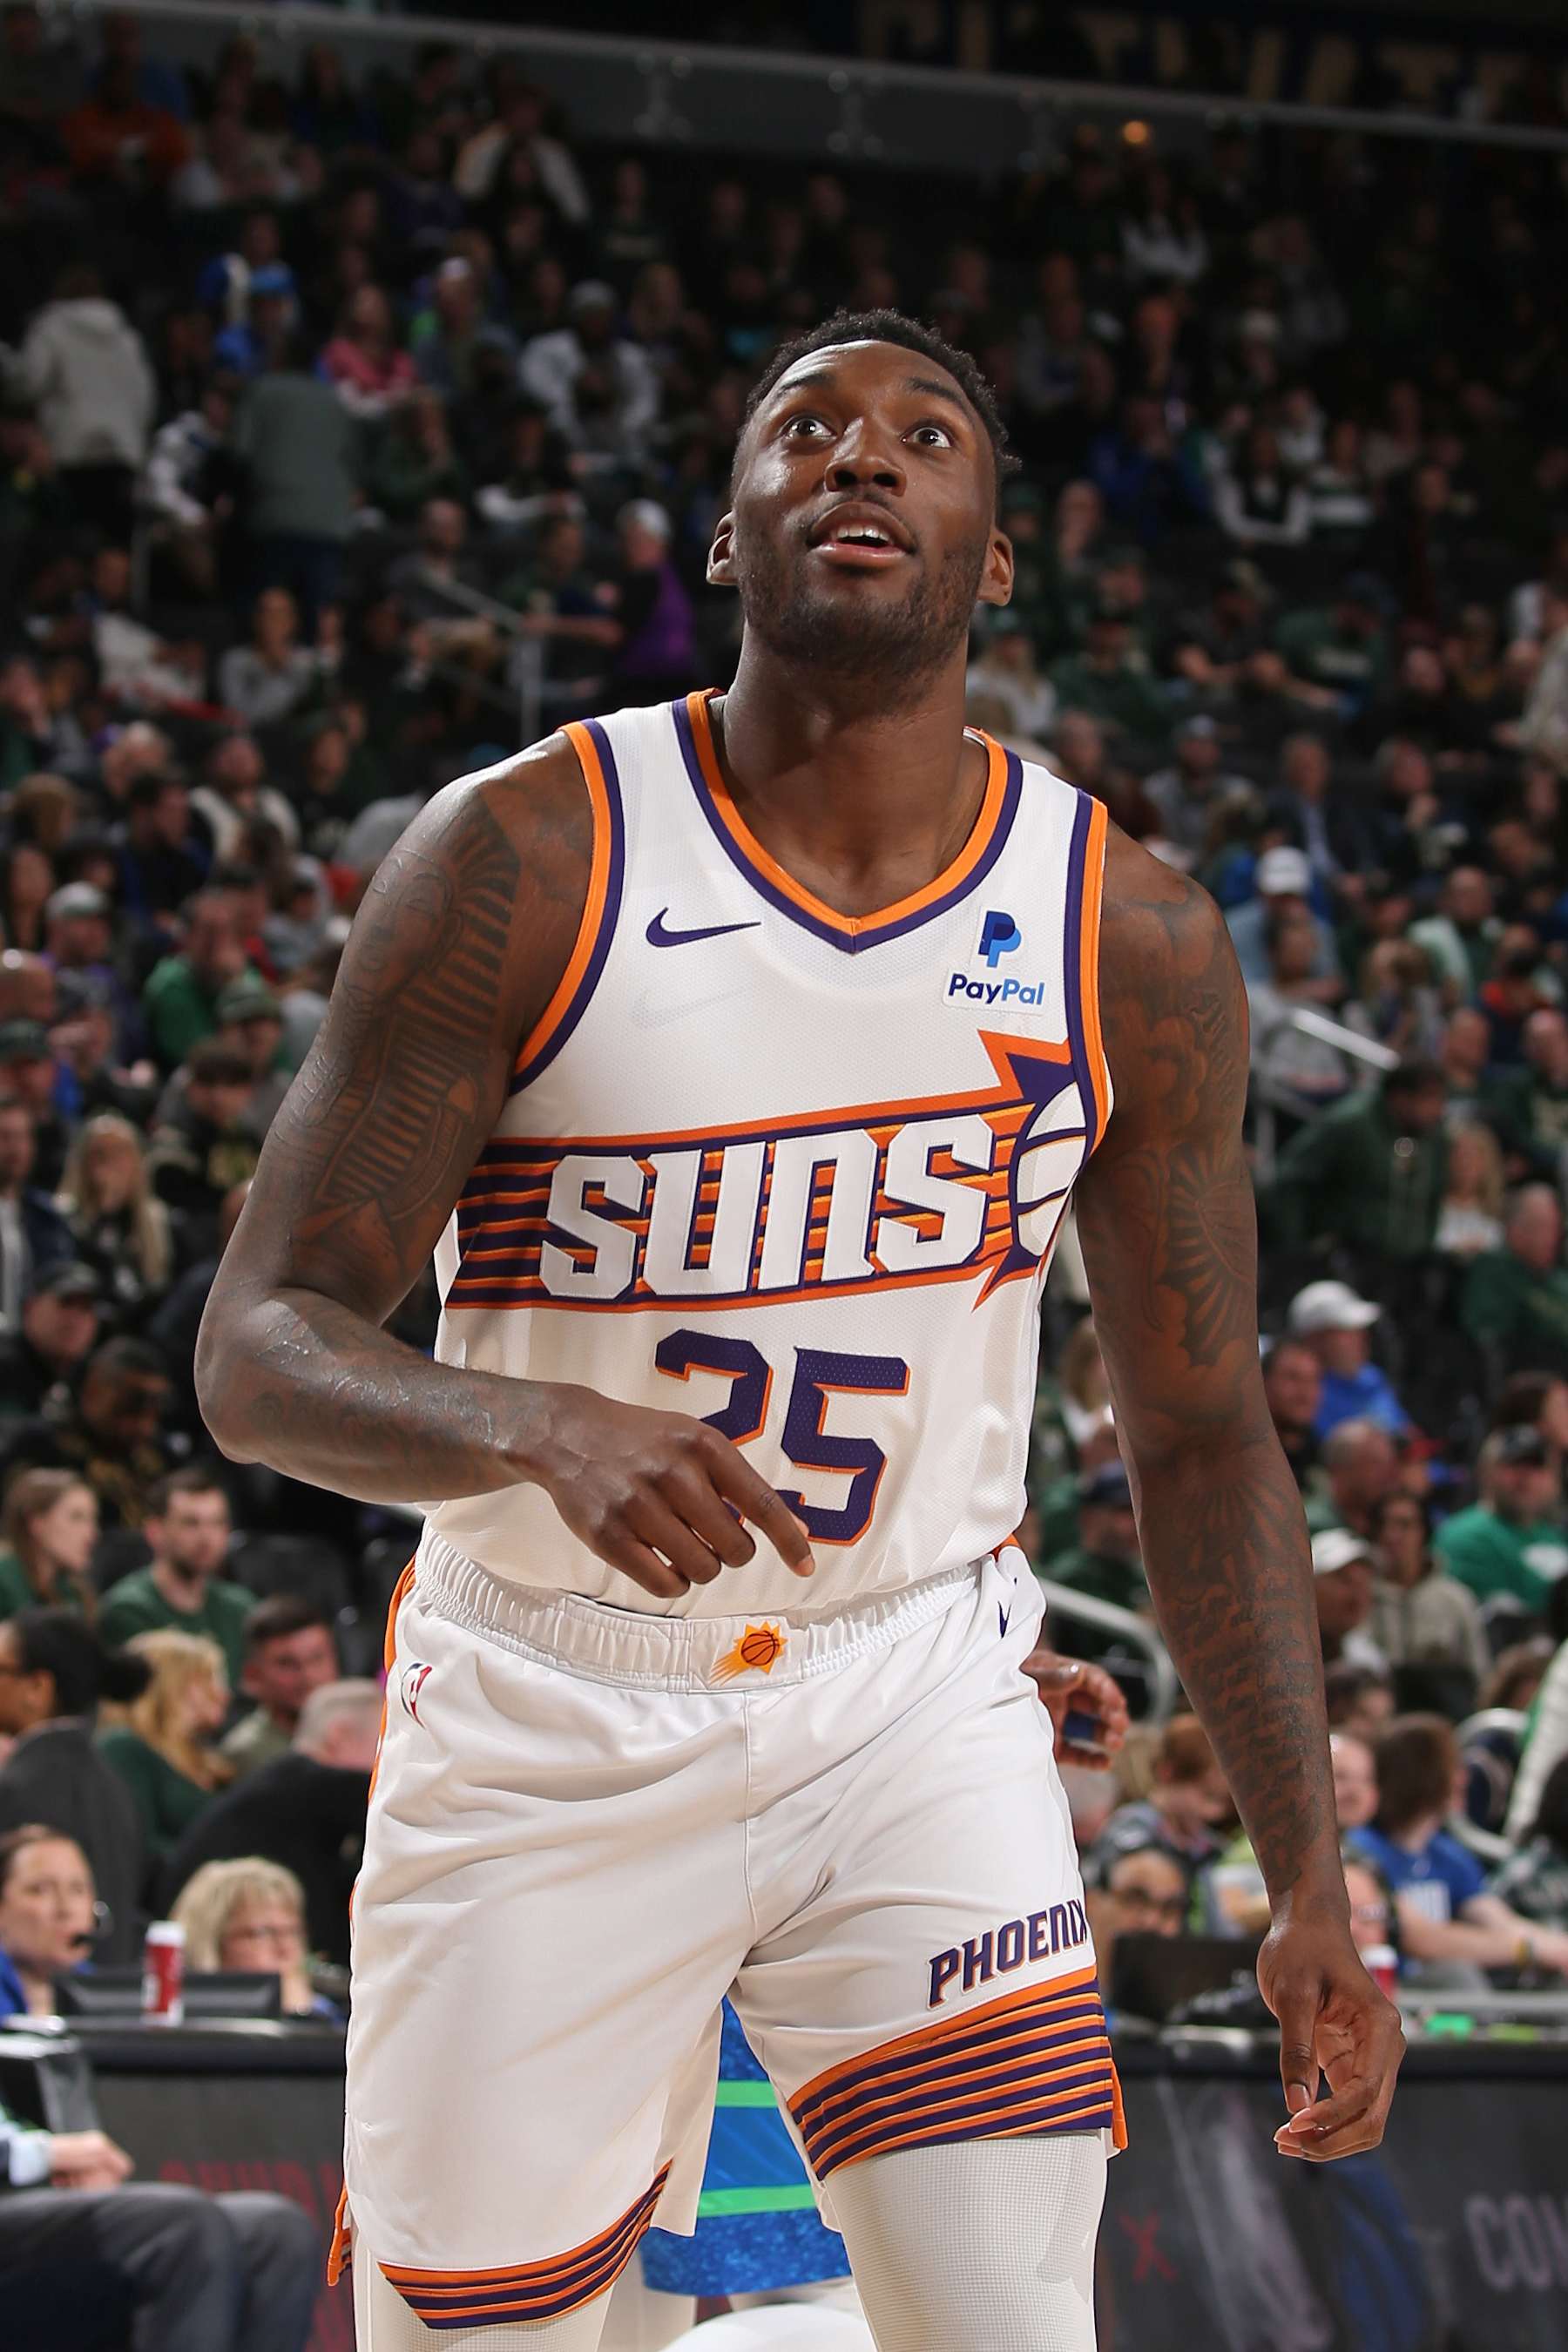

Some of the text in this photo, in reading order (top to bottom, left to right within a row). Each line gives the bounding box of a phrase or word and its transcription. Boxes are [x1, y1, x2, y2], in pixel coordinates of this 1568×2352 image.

[948, 973, 1045, 1005] PayPal
[538, 1113, 995, 1301] SUNS
[928, 1898, 1088, 2009] PHOENIX
